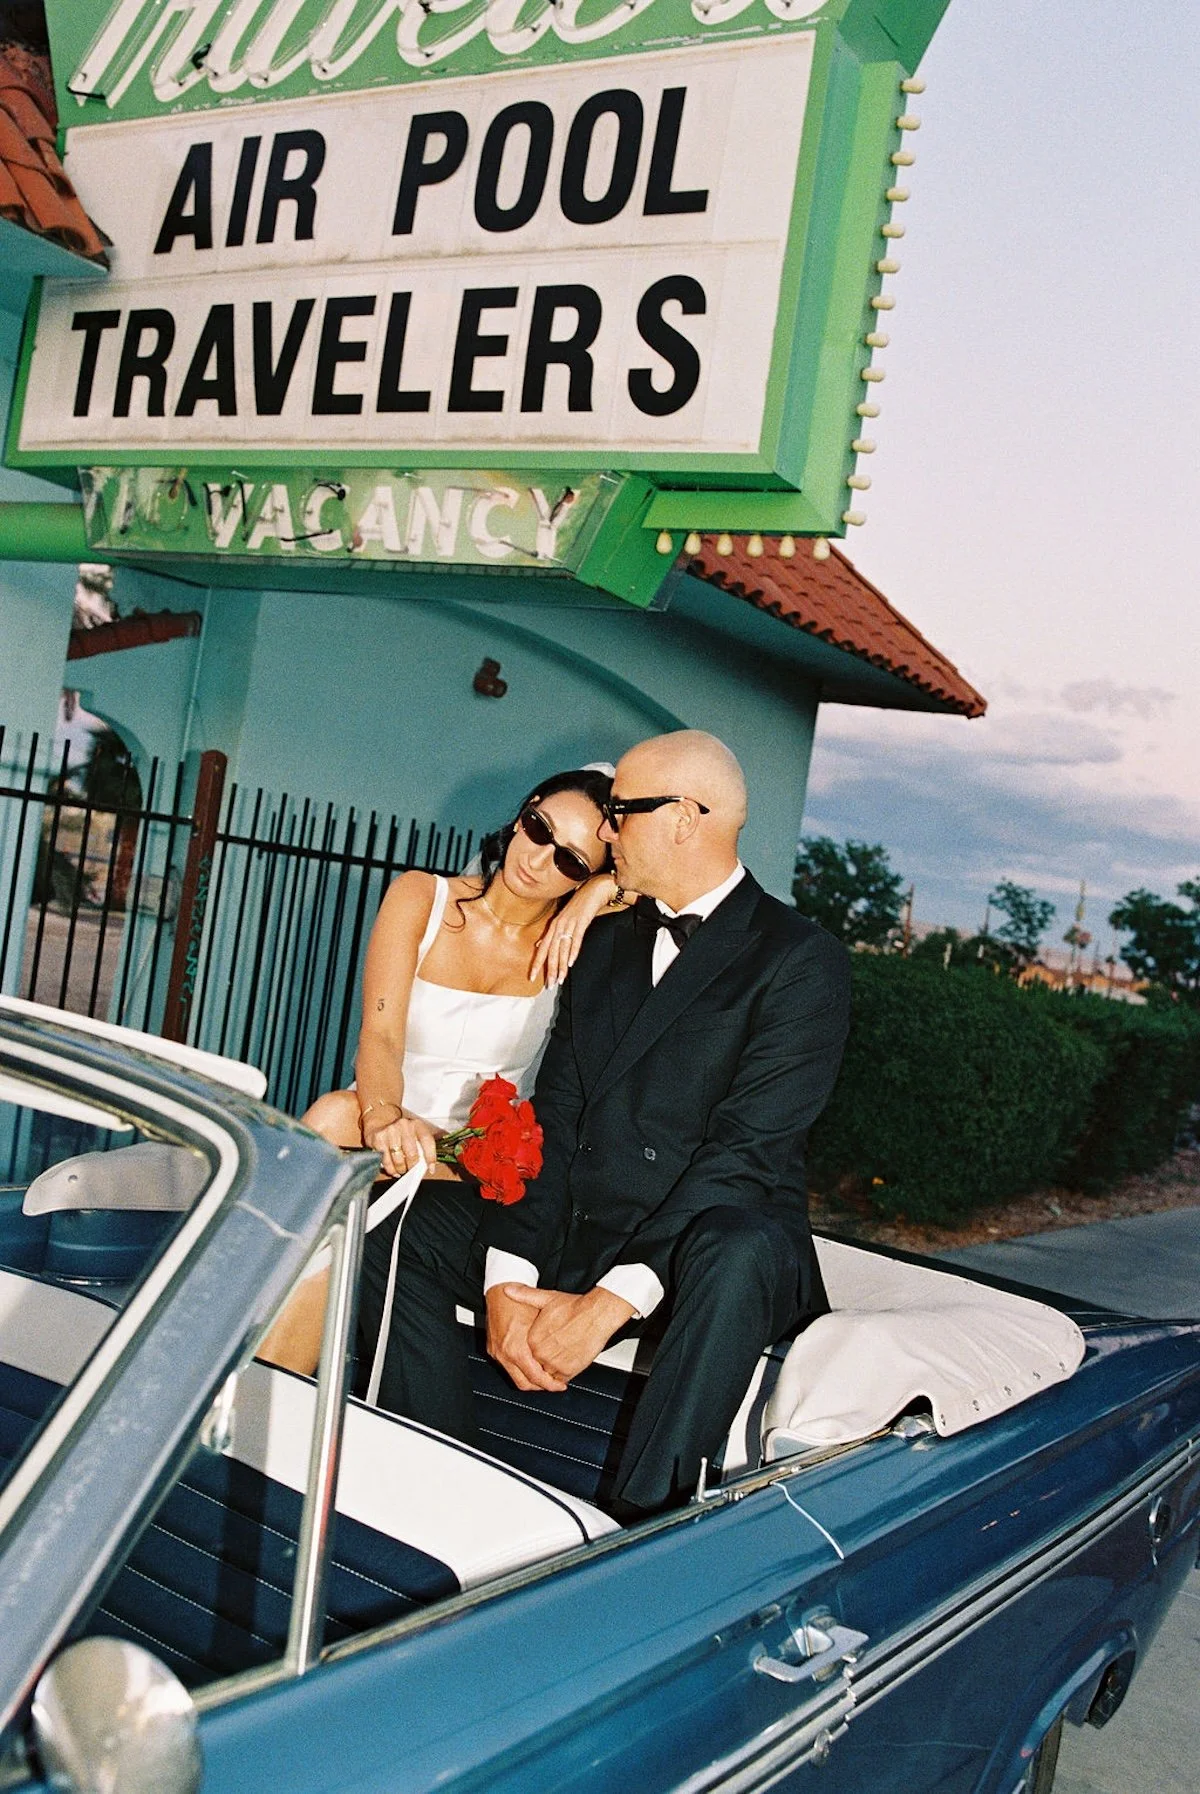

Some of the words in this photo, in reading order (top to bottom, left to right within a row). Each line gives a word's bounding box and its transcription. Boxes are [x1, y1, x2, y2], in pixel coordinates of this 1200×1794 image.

[153, 129, 327, 255] AIR
[391, 86, 709, 236] POOL
[71, 274, 707, 418] TRAVELERS
[204, 481, 581, 562] VACANCY
